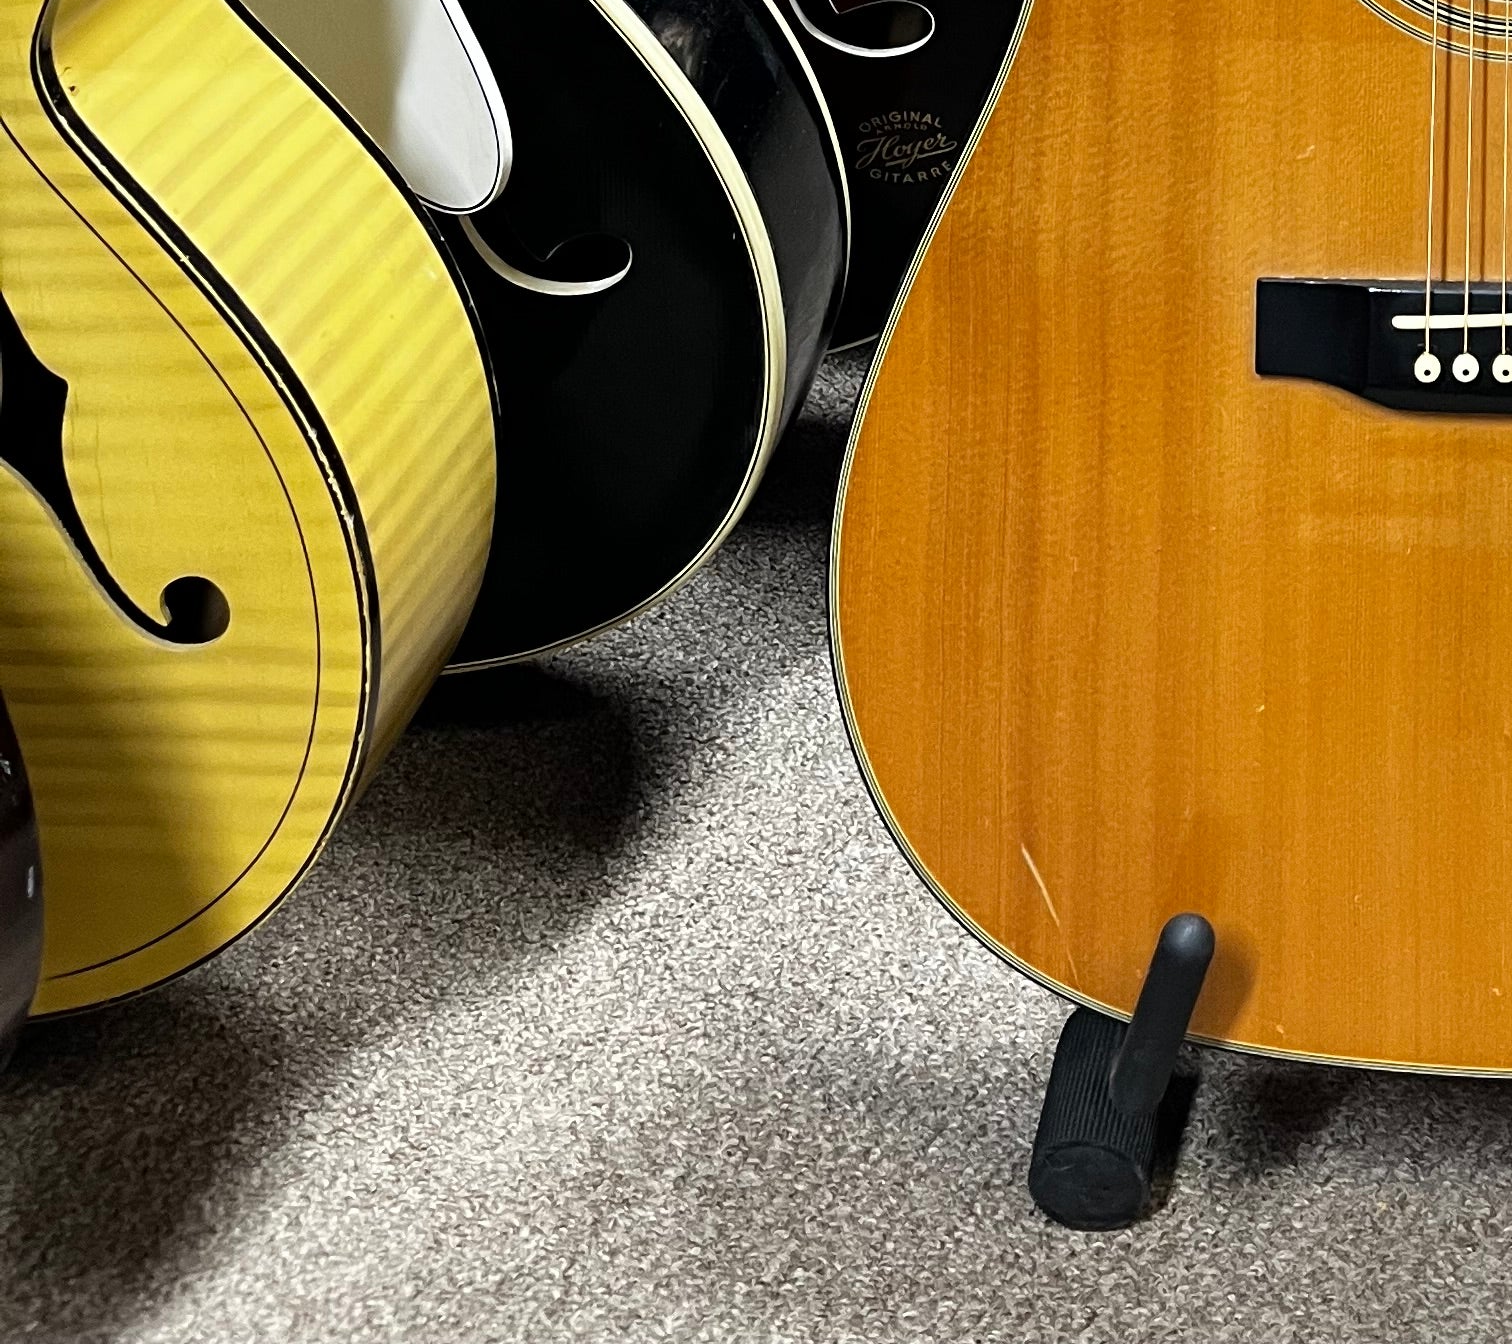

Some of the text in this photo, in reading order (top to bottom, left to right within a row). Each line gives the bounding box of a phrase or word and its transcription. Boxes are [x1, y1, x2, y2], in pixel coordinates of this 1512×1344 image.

[858, 110, 943, 133] ORIGINAL
[855, 132, 958, 170] Hoyer
[869, 160, 952, 184] GITARRE
